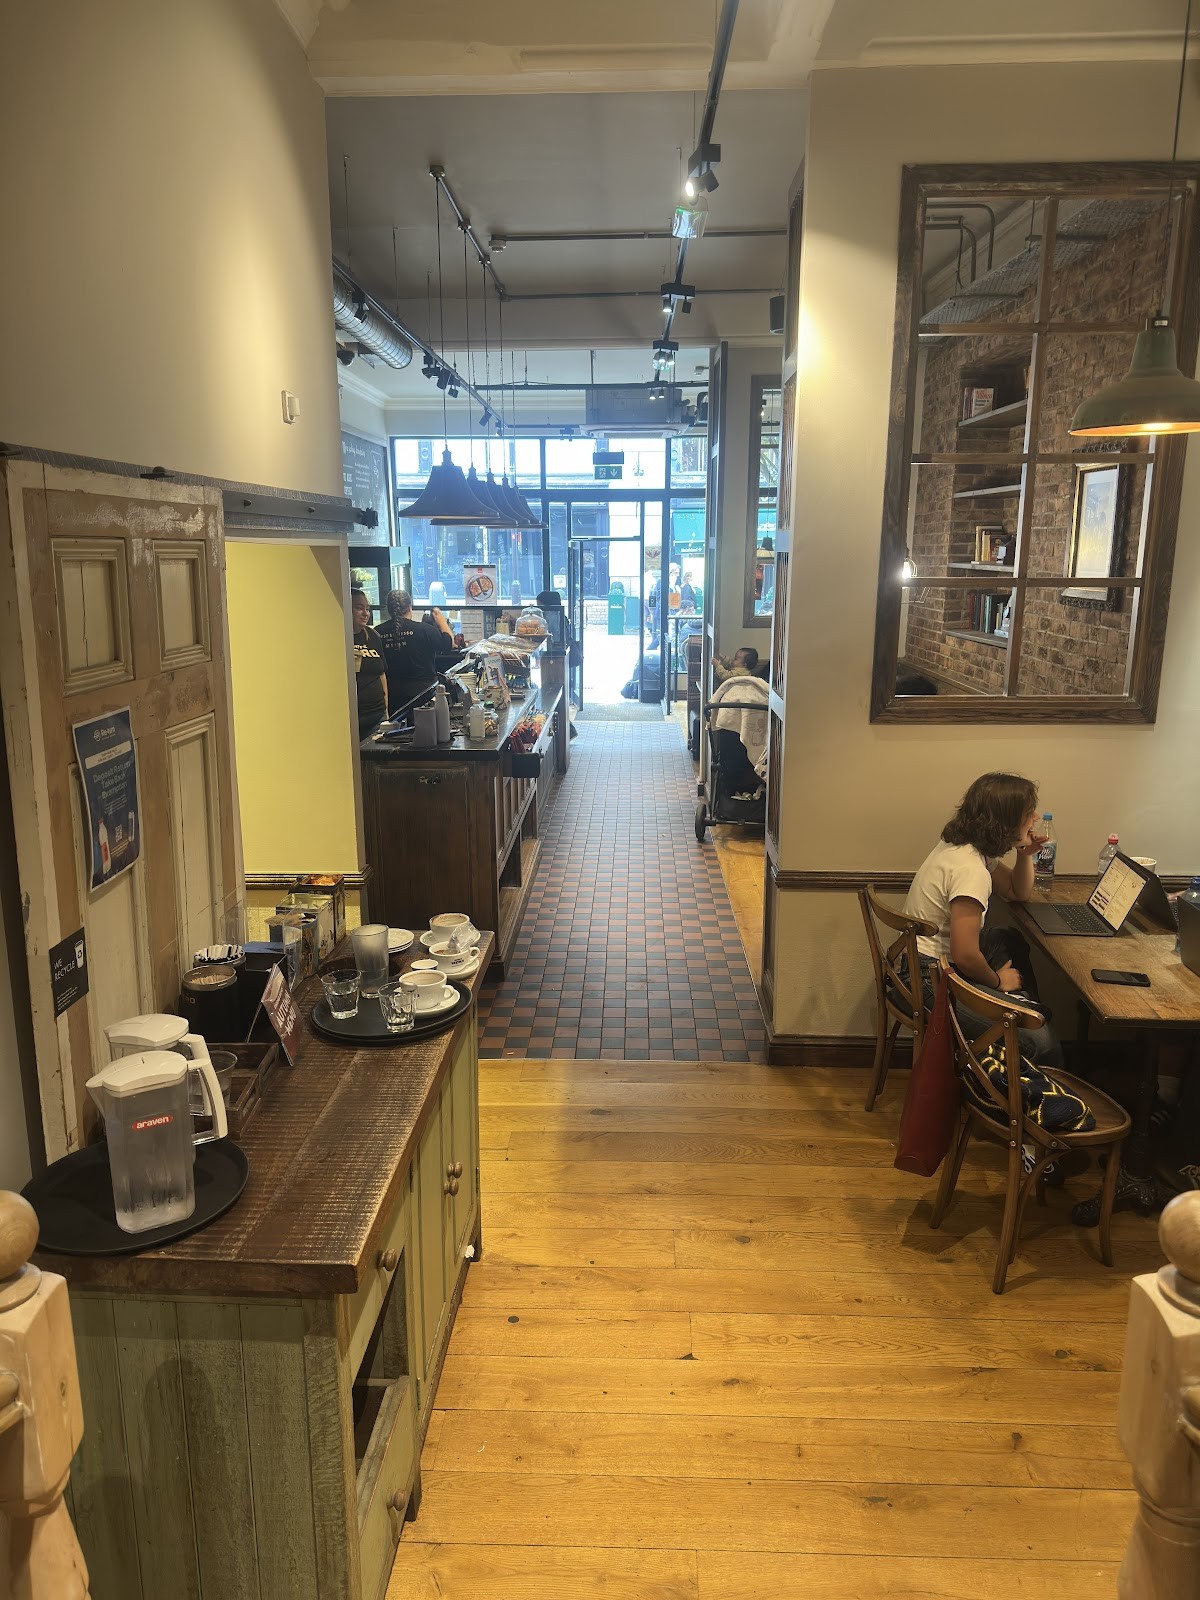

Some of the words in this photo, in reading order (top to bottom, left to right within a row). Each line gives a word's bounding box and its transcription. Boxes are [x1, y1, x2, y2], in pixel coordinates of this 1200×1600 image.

[54, 959, 63, 970] WE
[55, 961, 76, 981] RECYCLE
[136, 1116, 169, 1129] araven
